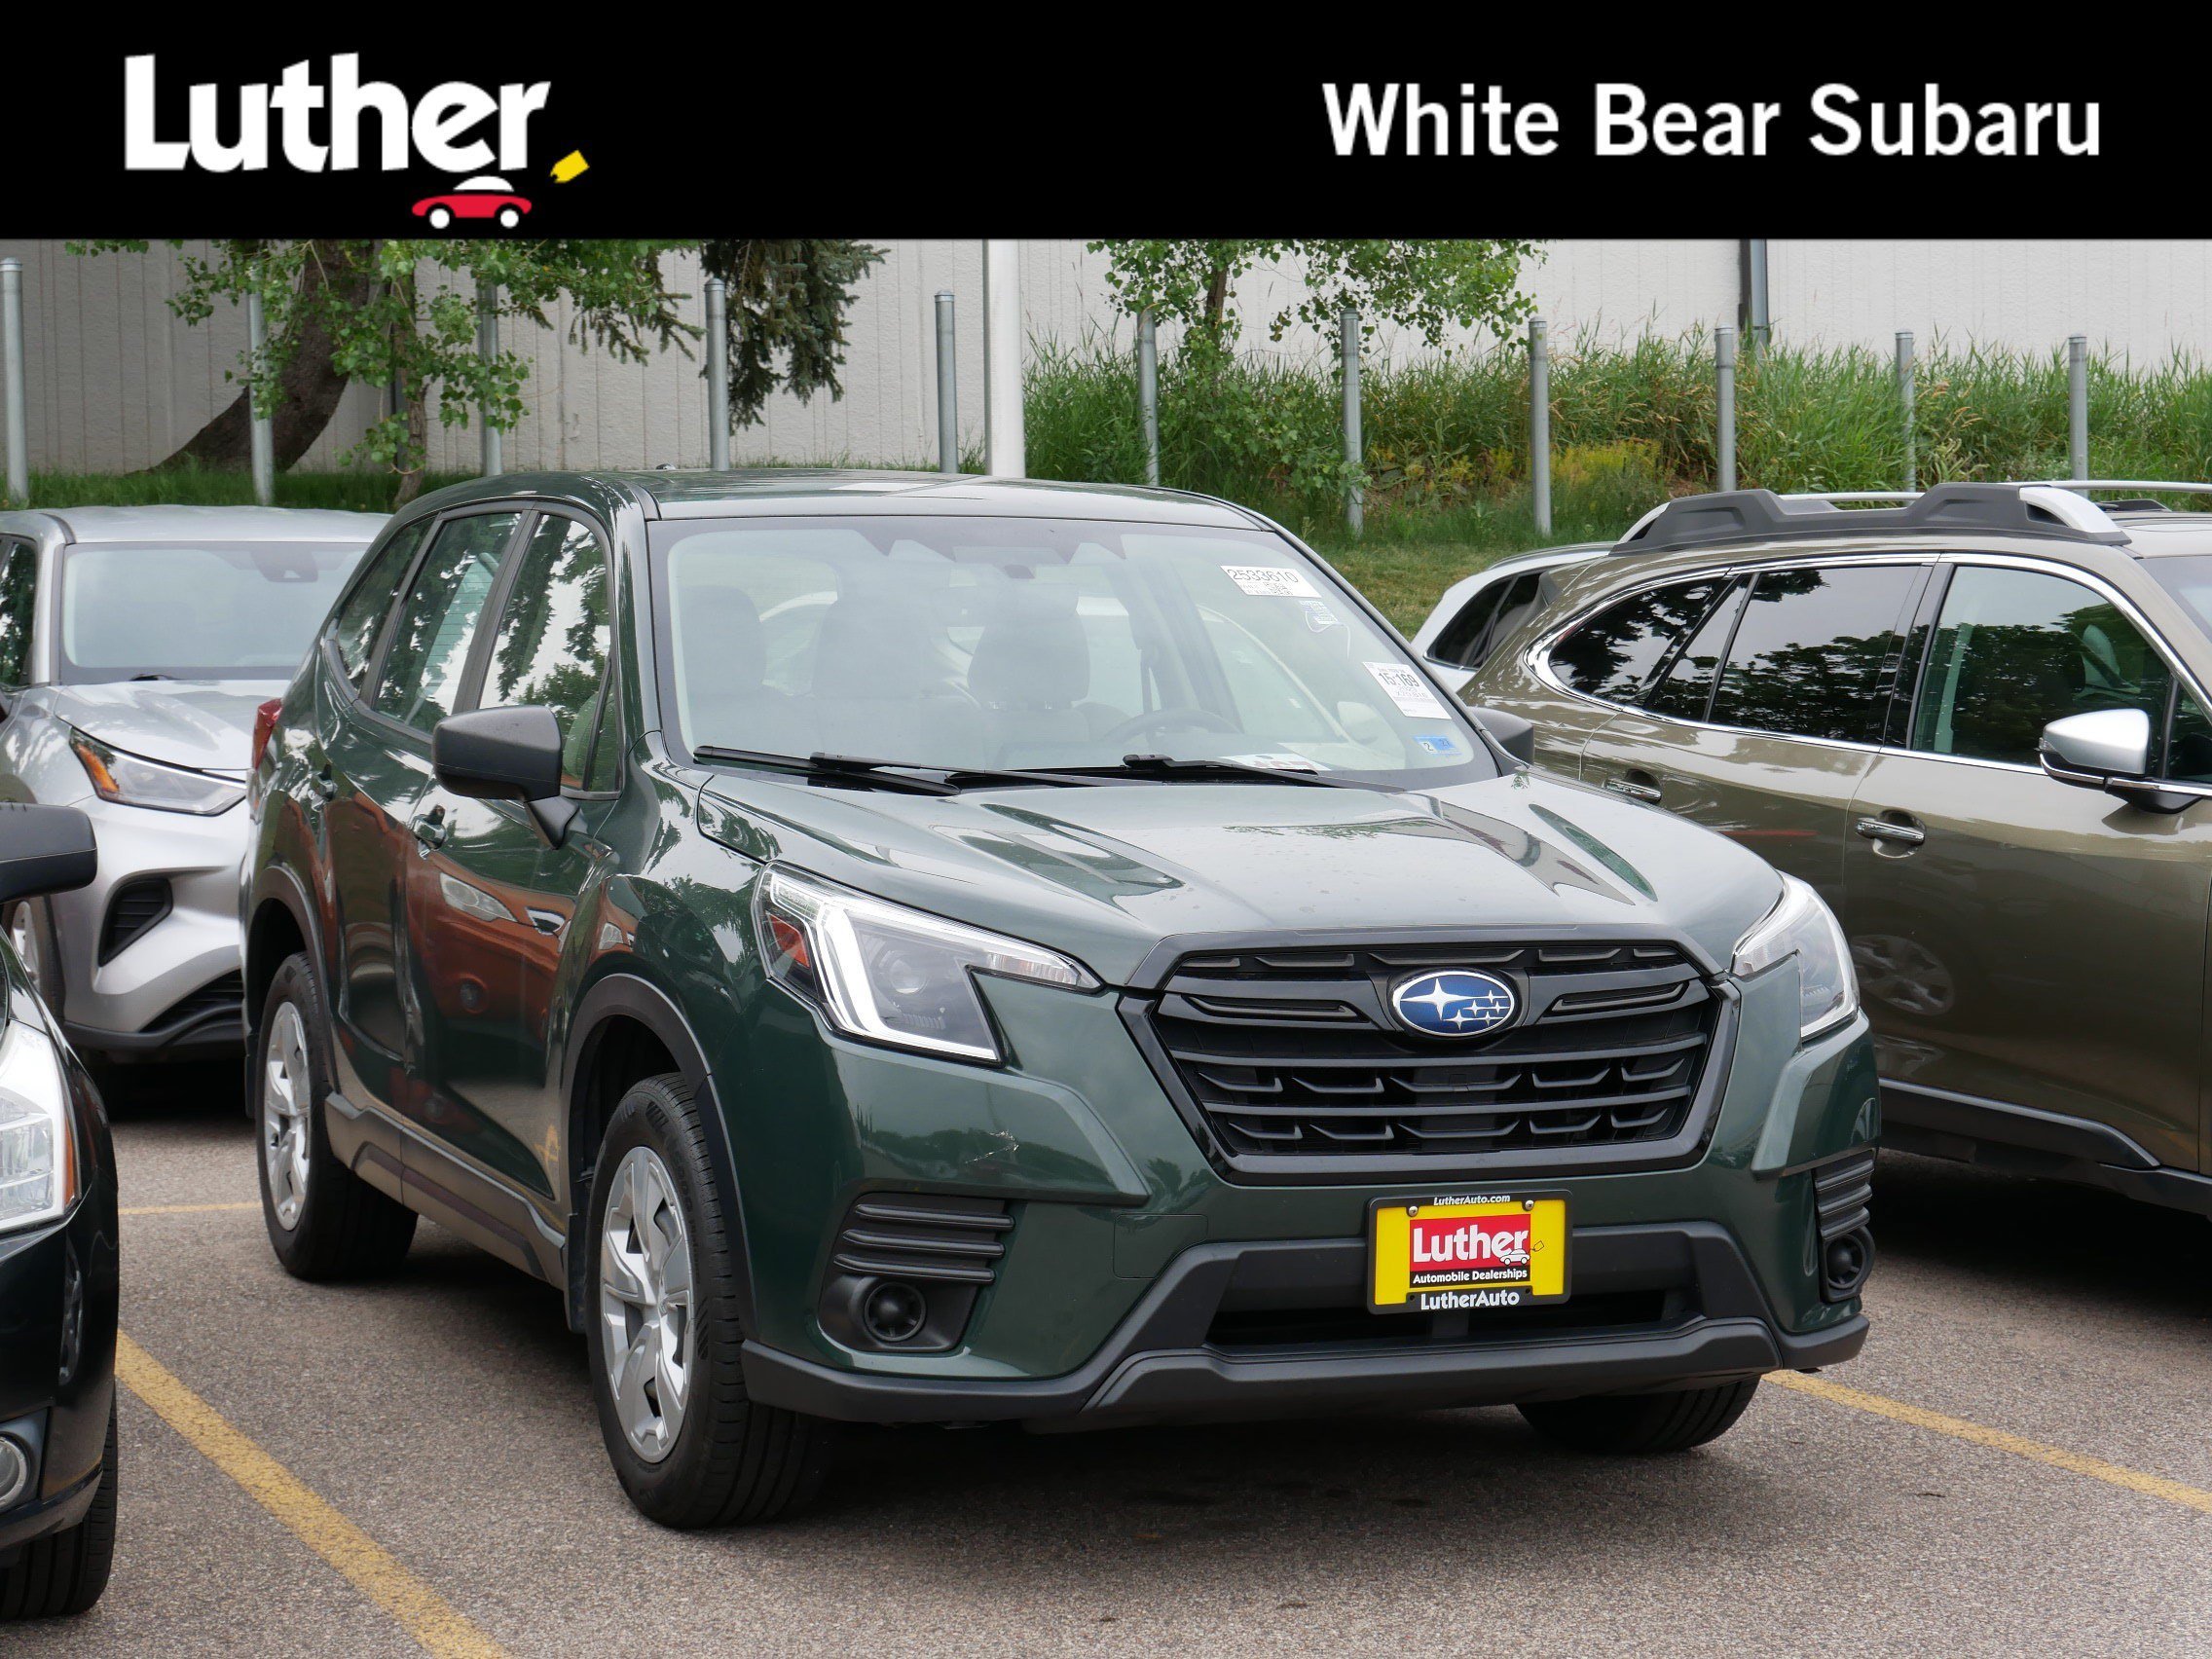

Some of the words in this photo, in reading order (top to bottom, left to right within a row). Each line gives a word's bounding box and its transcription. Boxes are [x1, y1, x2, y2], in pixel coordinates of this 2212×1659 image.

[1433, 1195, 1510, 1205] LutherAuto.com
[1413, 1224, 1529, 1263] Luther
[1413, 1272, 1469, 1284] Automobile
[1472, 1269, 1528, 1280] Dealerships
[1420, 1289, 1520, 1310] LutherAuto
